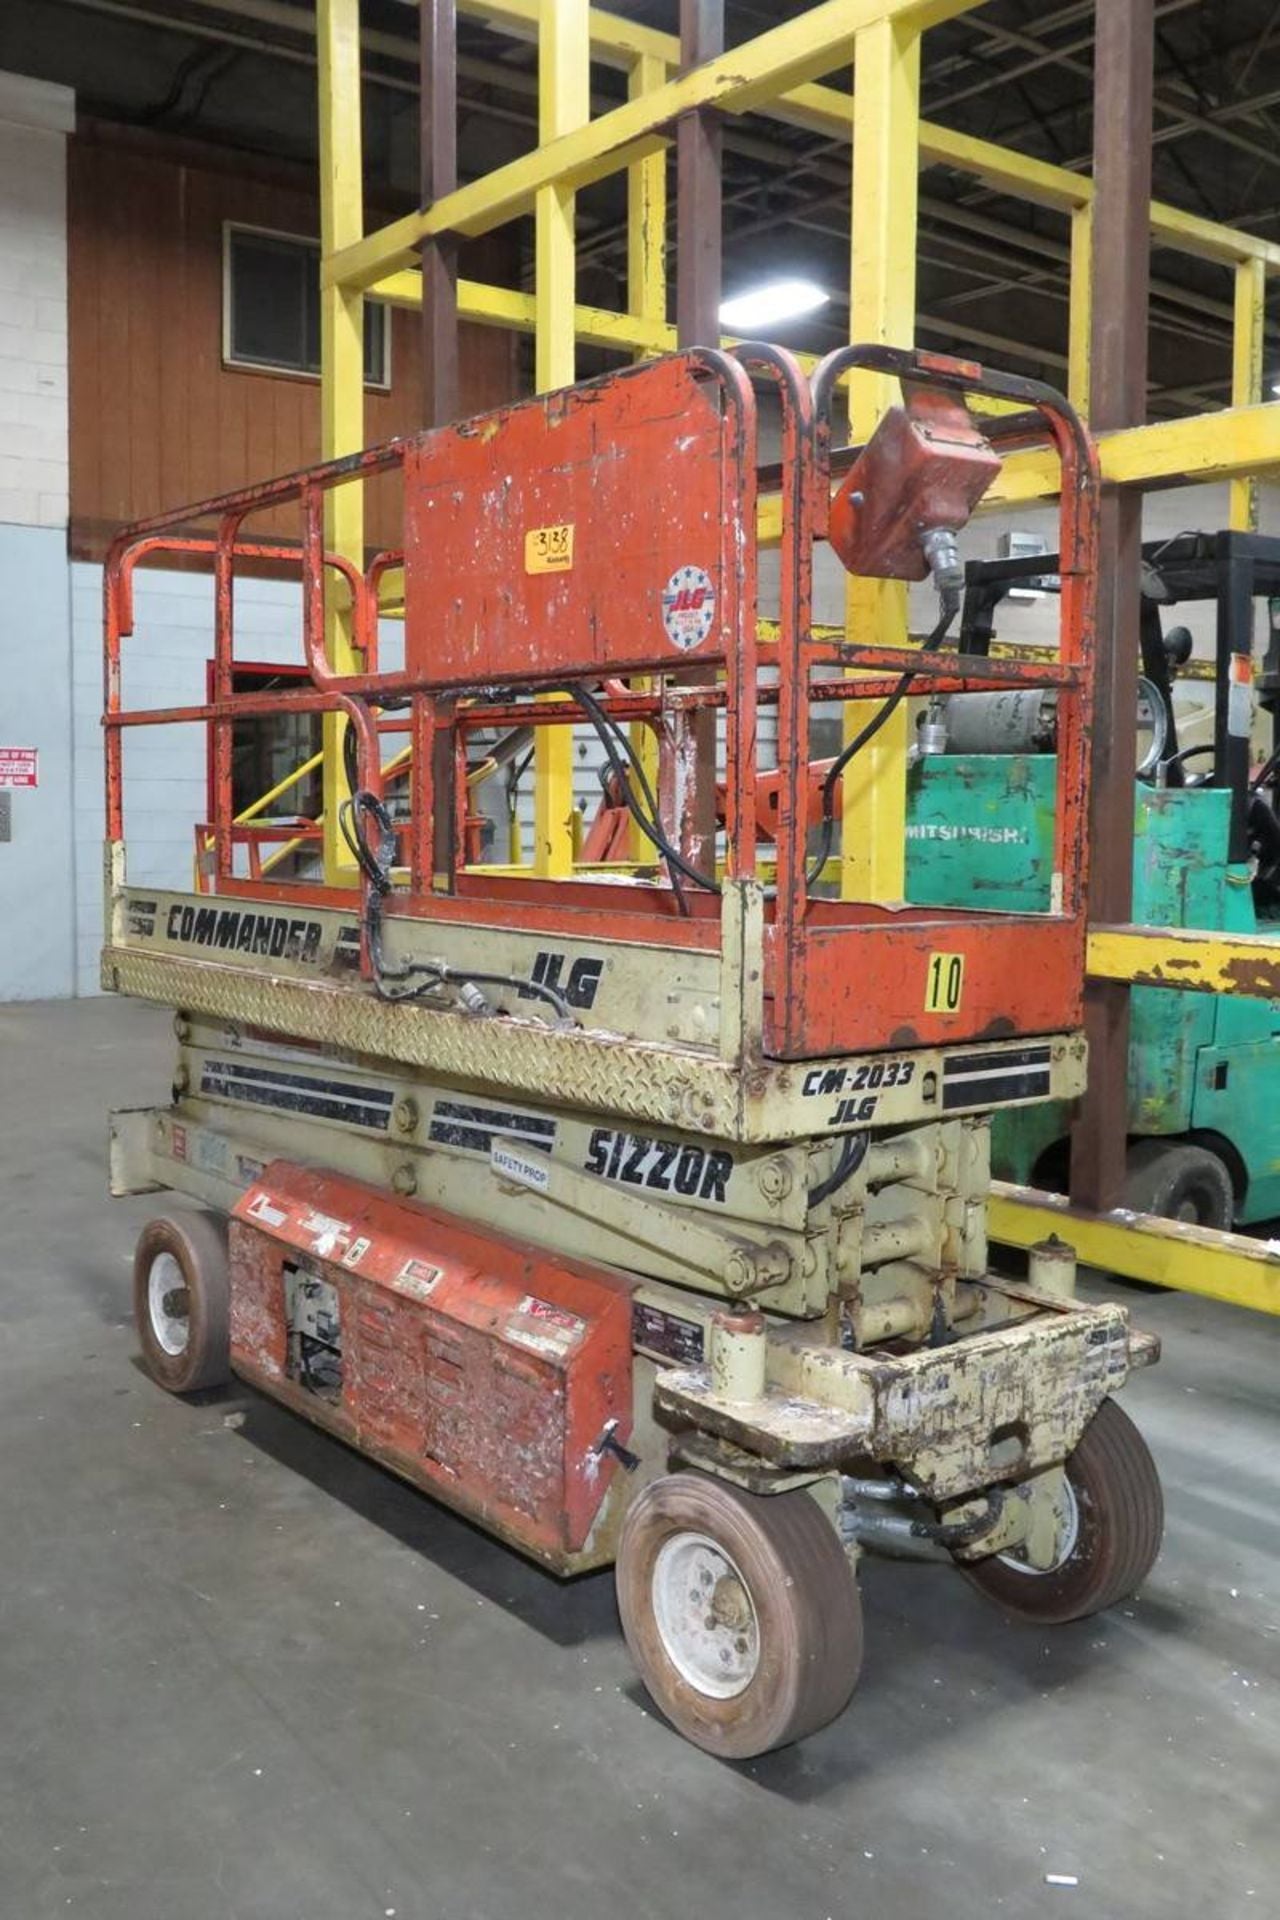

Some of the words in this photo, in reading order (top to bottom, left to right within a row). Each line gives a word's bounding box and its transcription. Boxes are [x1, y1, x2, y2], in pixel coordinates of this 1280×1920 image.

[537, 527, 569, 556] 3138
[669, 588, 706, 611] JLG
[167, 904, 323, 964] COMMANDER
[518, 951, 604, 1010] JLG
[932, 957, 961, 1009] 10
[802, 1061, 916, 1097] CM-2033
[828, 1096, 878, 1126] JLG
[494, 1152, 523, 1173] SAFETY
[523, 1164, 547, 1182] PROP
[584, 1128, 734, 1203] SIZZOR
